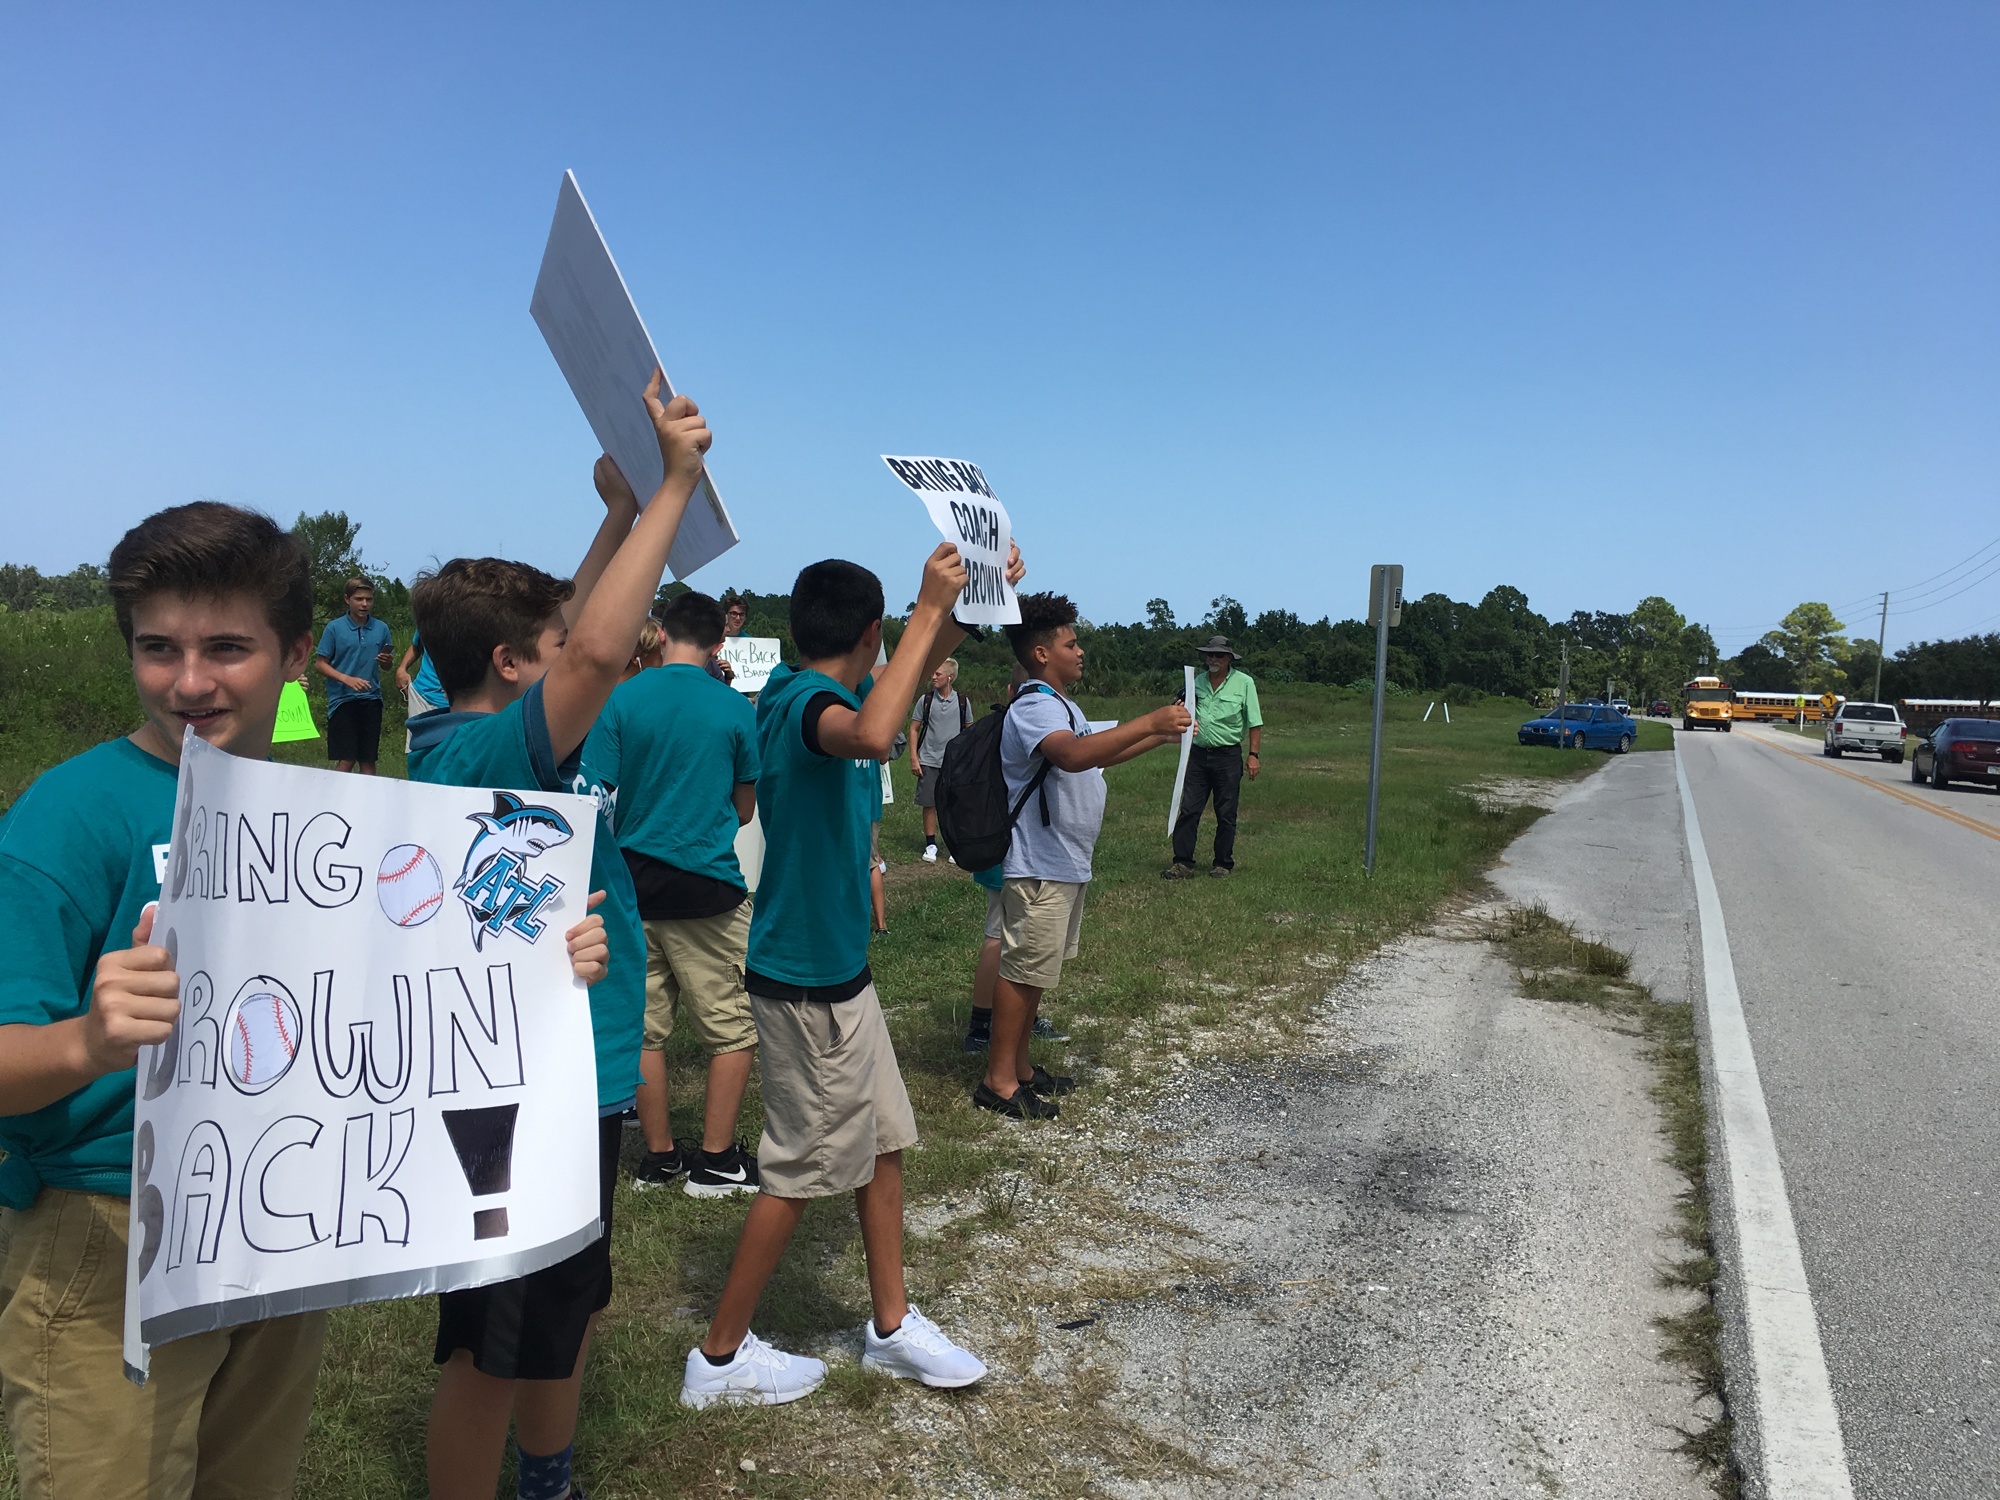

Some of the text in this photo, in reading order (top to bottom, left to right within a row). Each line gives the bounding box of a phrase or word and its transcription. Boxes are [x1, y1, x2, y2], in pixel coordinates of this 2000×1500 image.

[886, 458, 1000, 501] BRING BACK
[950, 501, 999, 552] COACH
[963, 558, 1006, 606] BROWN
[742, 665, 772, 678] BROW
[171, 763, 362, 909] BRING
[460, 849, 563, 942] ATL
